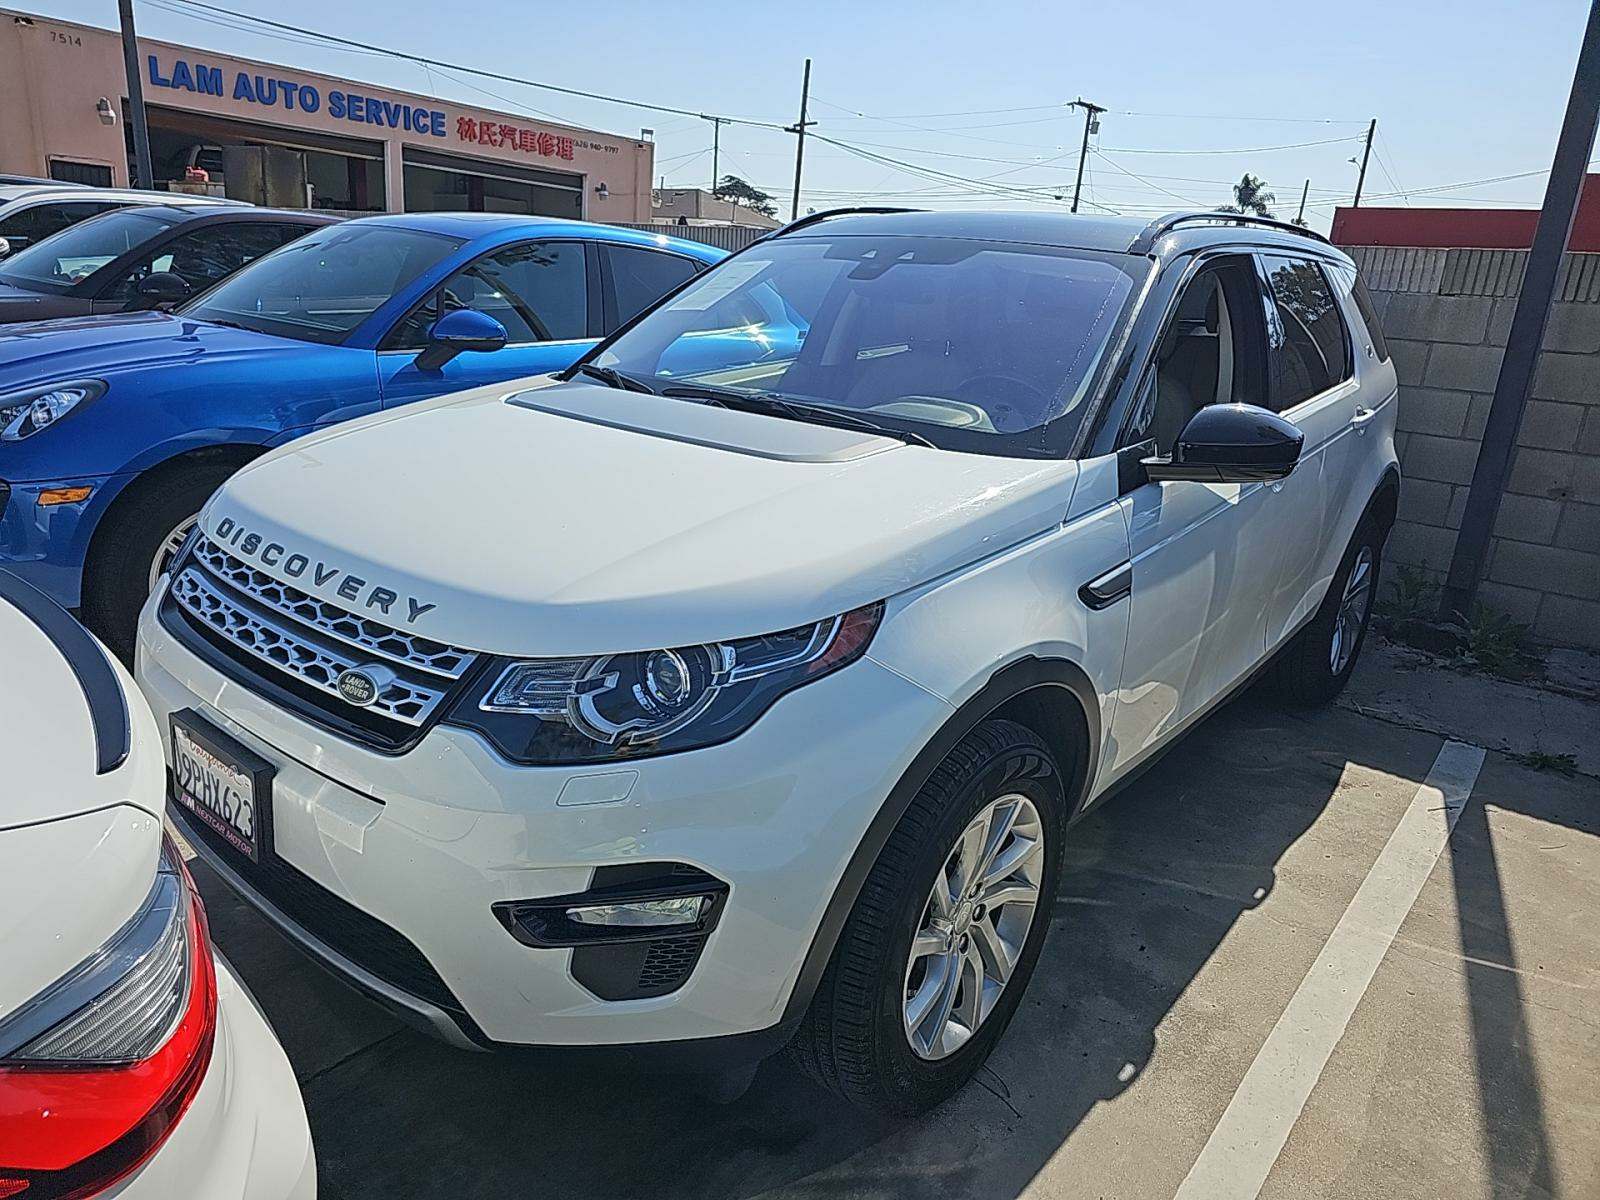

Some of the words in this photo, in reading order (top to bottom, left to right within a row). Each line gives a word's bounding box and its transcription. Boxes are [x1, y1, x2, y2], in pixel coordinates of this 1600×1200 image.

[50, 31, 82, 47] 7514
[148, 55, 223, 97] LAM
[233, 72, 320, 113] AUTO
[328, 90, 446, 137] SERVICE
[456, 116, 574, 161] 林氏汽車修理
[216, 517, 437, 623] DISCOVERY
[344, 684, 369, 699] ROVER
[345, 674, 366, 688] LAND
[181, 752, 253, 841] 9PHX623
[226, 829, 253, 857] MOTOR
